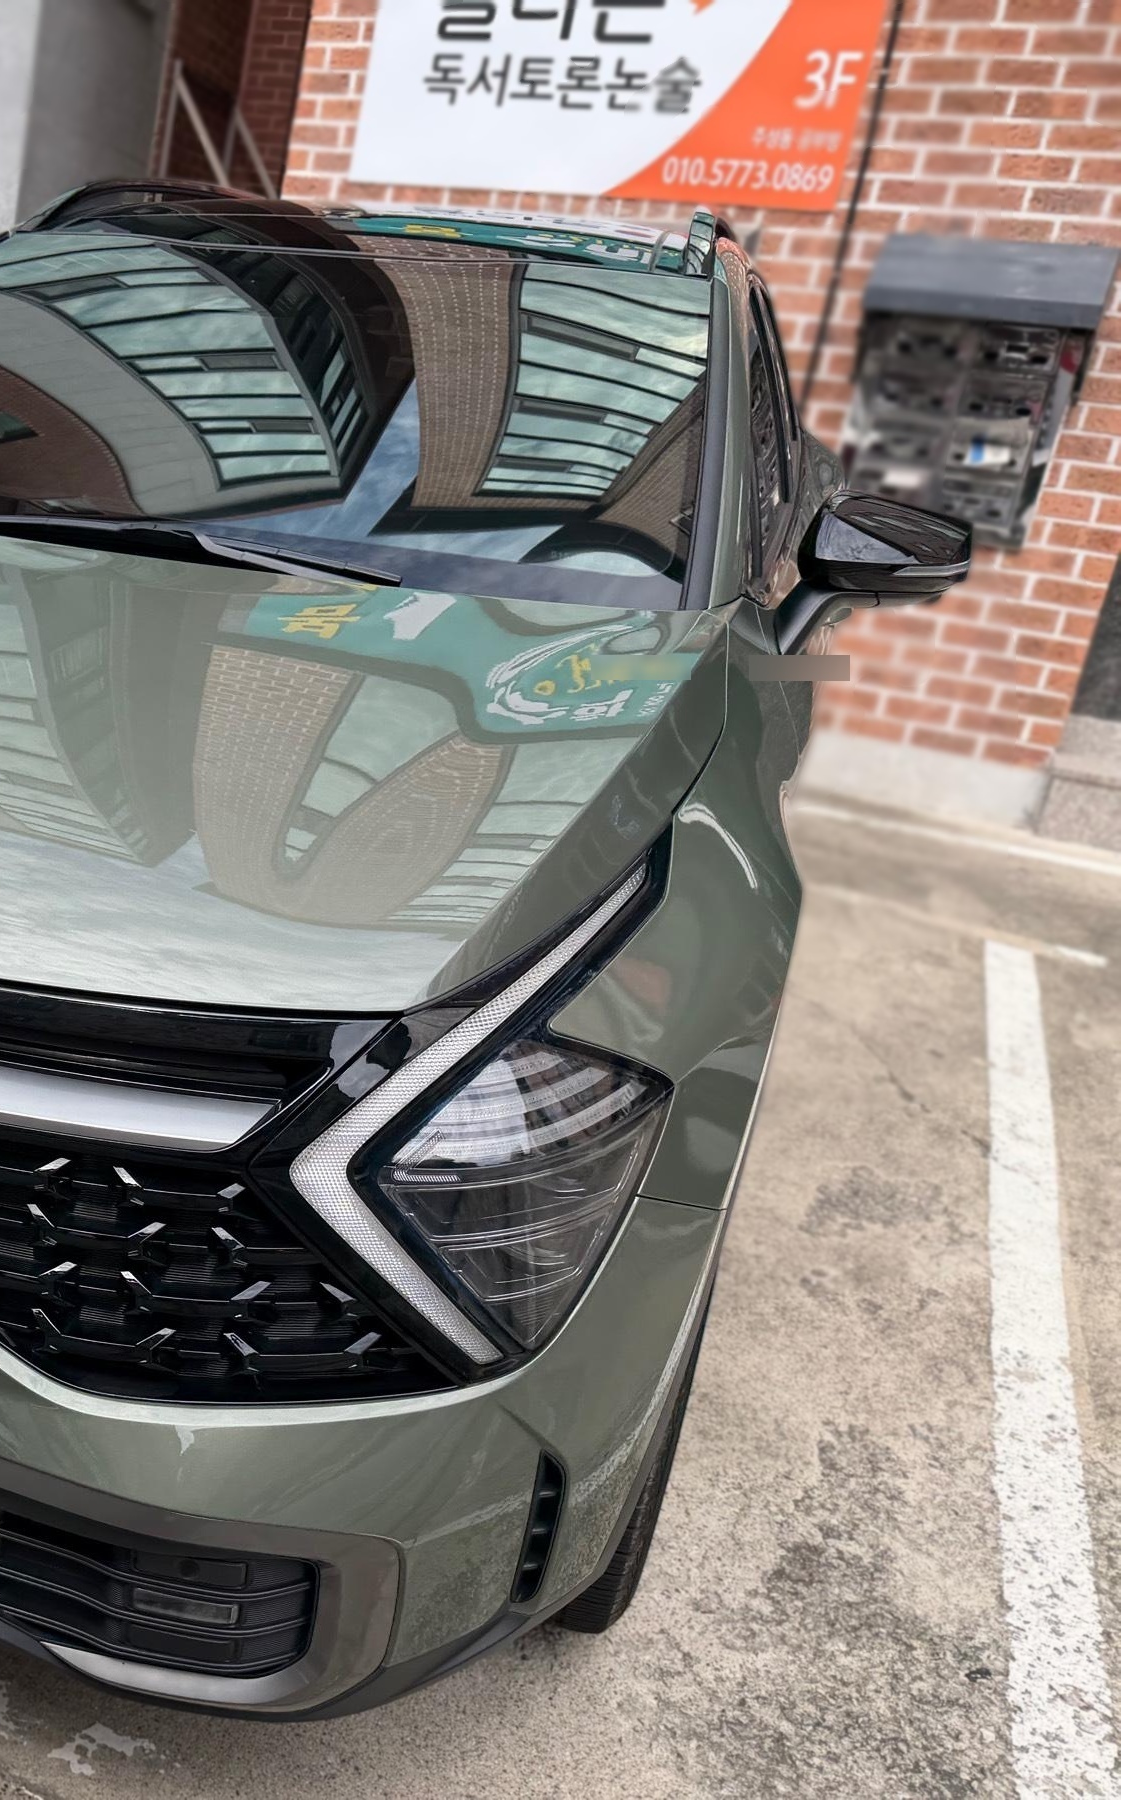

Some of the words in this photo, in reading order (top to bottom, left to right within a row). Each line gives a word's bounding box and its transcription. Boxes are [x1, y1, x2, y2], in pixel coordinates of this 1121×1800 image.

[423, 52, 702, 114] 독서토론논술
[795, 49, 863, 110] 3F
[661, 156, 834, 192] 010.5773.0869
